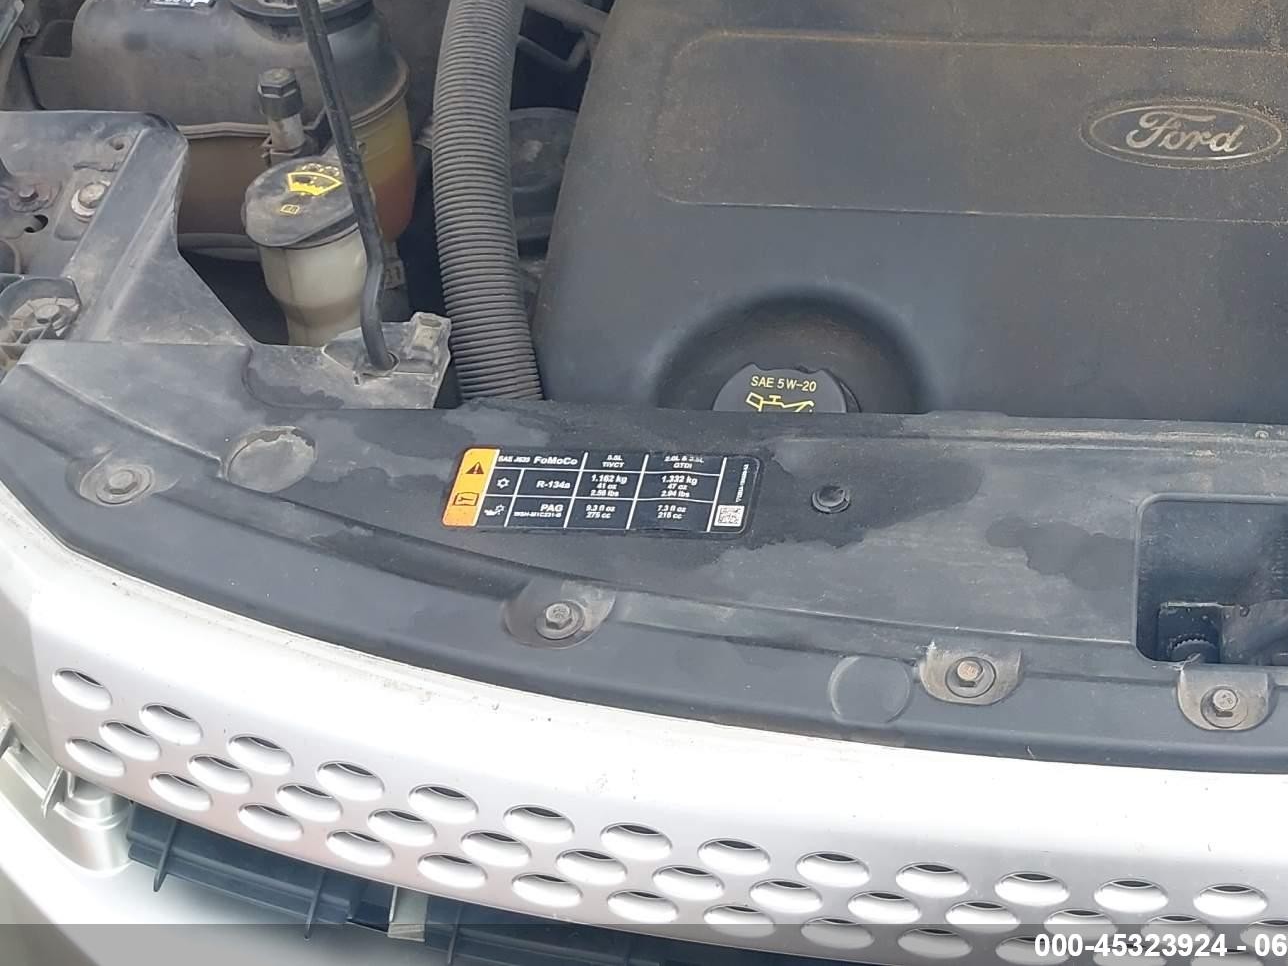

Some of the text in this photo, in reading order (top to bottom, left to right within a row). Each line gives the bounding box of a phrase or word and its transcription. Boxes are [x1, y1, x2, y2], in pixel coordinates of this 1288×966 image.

[1125, 111, 1246, 153] Ford
[750, 375, 817, 393] SAE 5W-20
[533, 456, 578, 465] FoMoCo
[591, 474, 628, 484] 1.162 kg
[661, 475, 698, 486] 1.332 kg
[536, 480, 571, 489] R-134a
[607, 489, 619, 497] lbs
[540, 504, 564, 512] PAG
[585, 504, 598, 512] 9.3
[657, 504, 669, 512] 7.3
